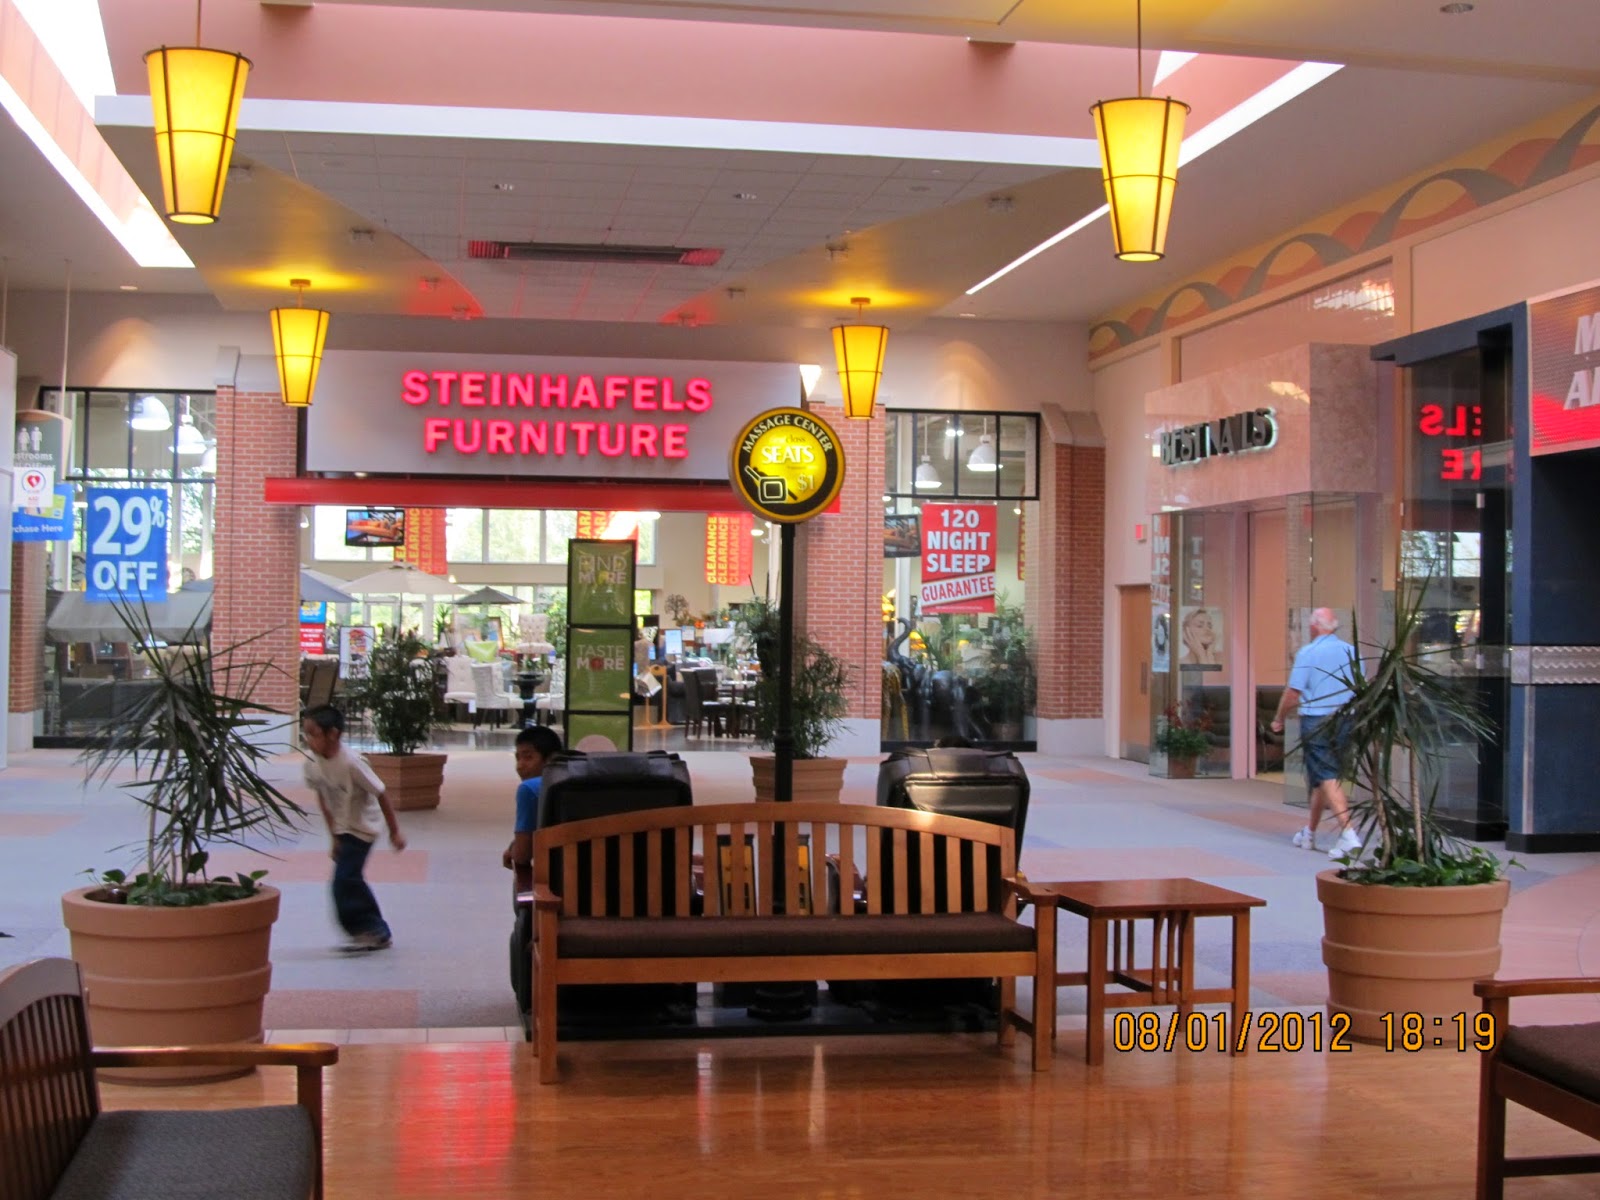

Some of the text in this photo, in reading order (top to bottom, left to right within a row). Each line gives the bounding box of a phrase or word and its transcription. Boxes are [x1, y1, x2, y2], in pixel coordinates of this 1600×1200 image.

[401, 370, 713, 412] STEINHAFELS
[424, 418, 689, 458] FURNITURE
[742, 415, 833, 453] MASSAGE CENTER
[761, 445, 815, 464] SEATS
[796, 473, 815, 491] $1
[41, 524, 63, 533] Here
[941, 509, 980, 528] 120
[706, 517, 717, 584] CLEARANCE
[717, 517, 728, 584] CLEARANCE
[927, 531, 991, 551] NIGHT
[926, 553, 991, 573] SLEEP
[92, 560, 158, 591] OFF
[921, 575, 995, 603] GUARANTEE
[577, 644, 625, 658] TASTE
